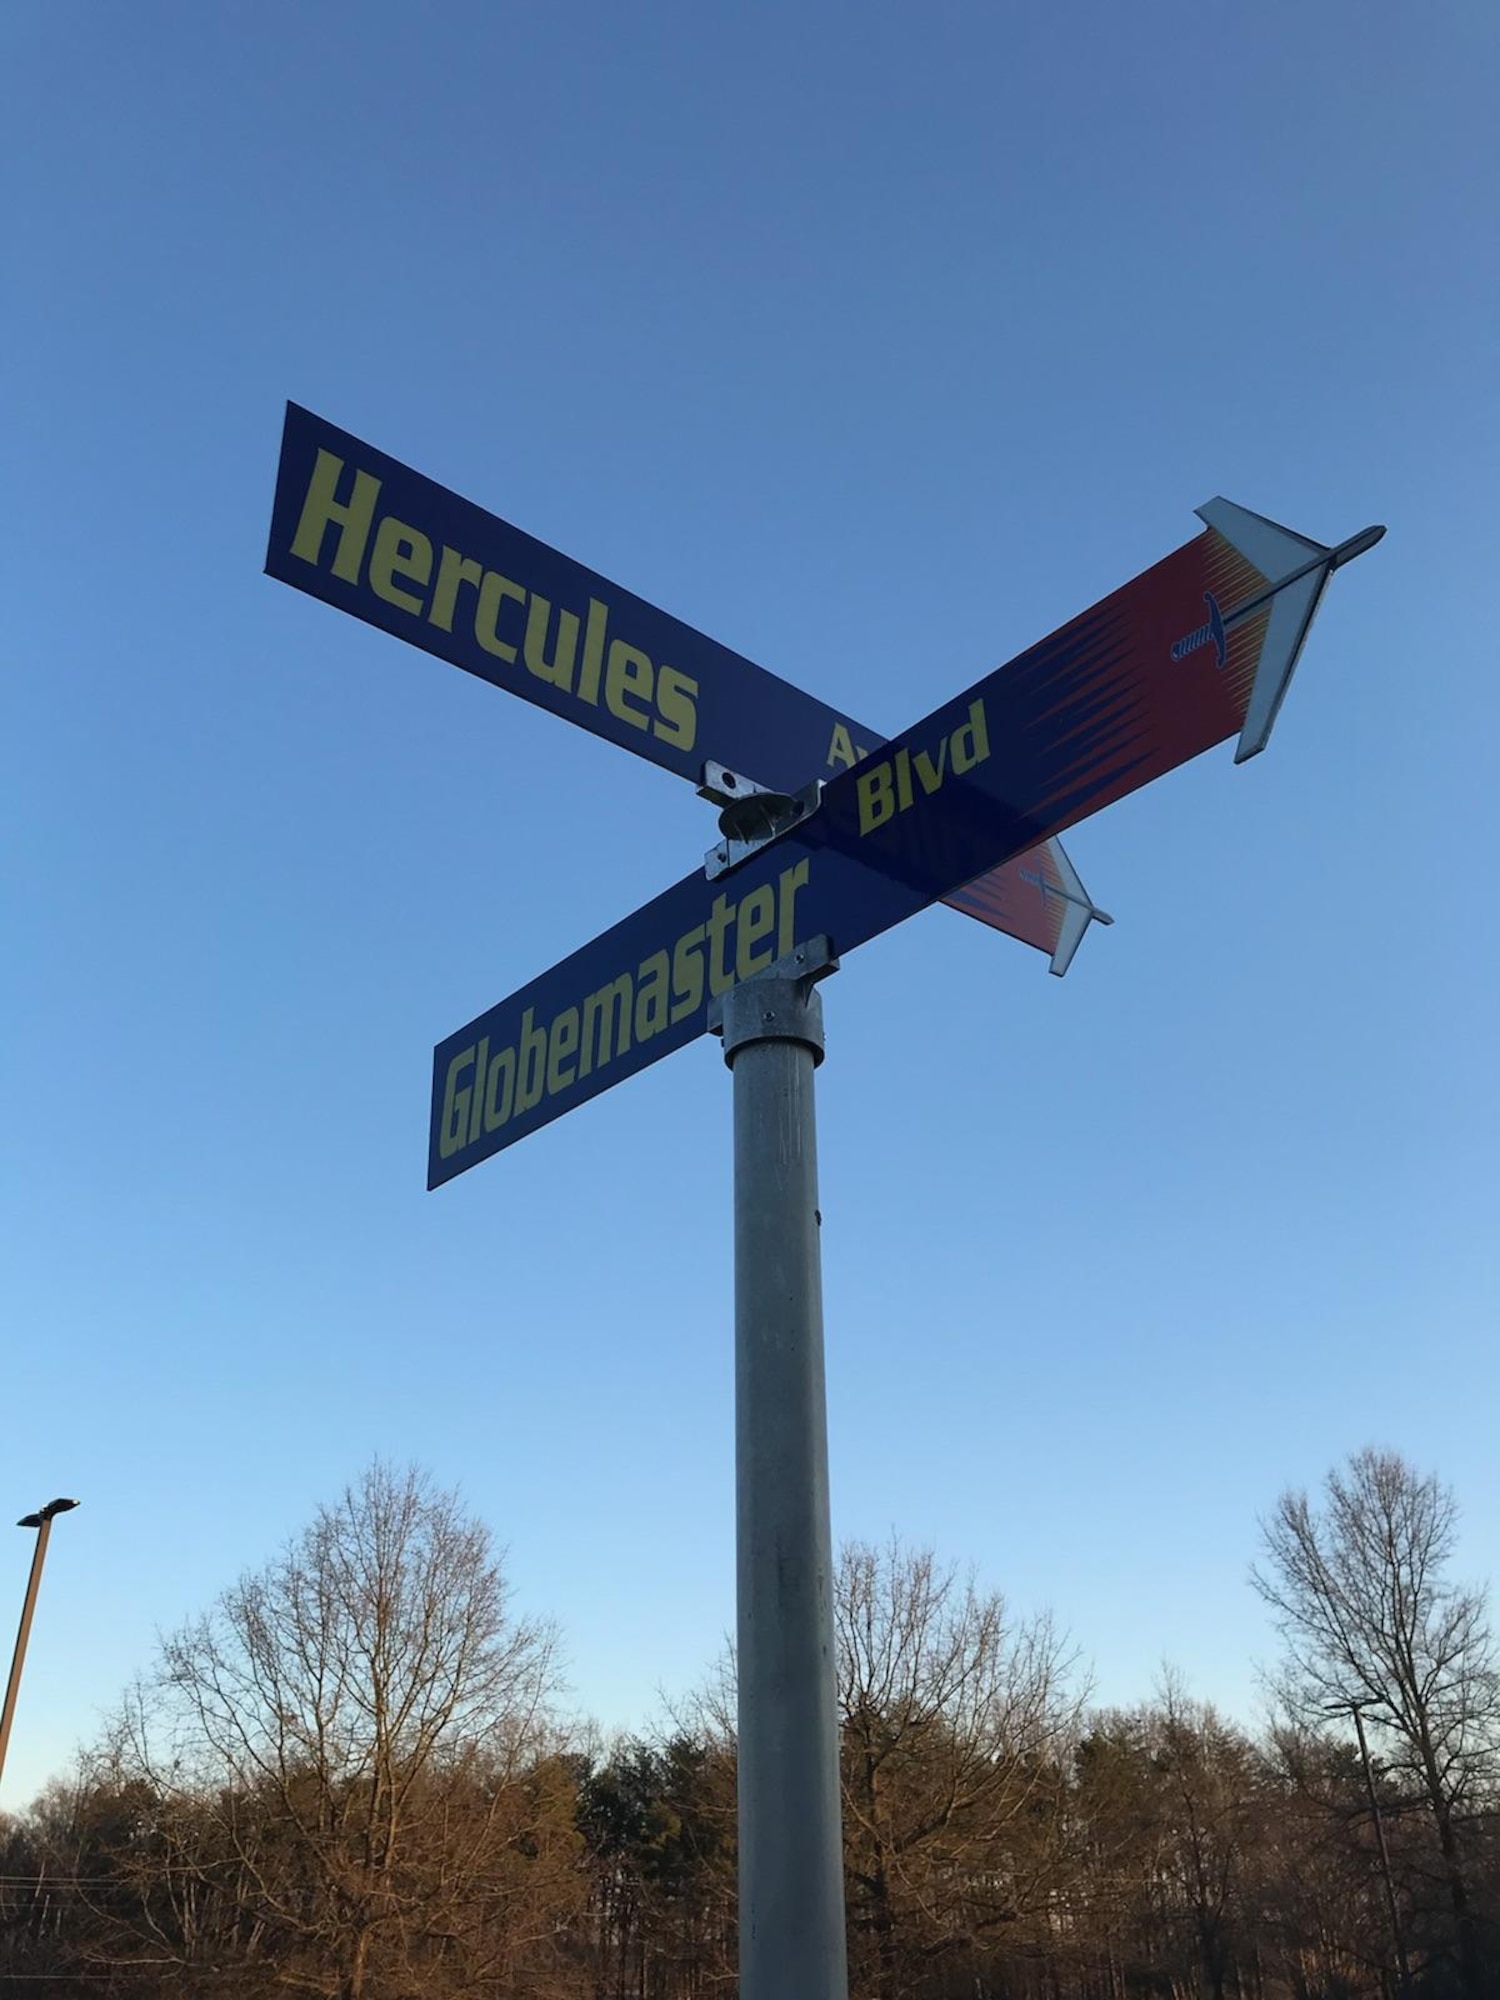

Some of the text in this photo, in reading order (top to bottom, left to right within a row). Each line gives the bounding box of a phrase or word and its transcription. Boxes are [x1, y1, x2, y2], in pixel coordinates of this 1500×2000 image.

[290, 447, 699, 752] Hercules
[439, 698, 991, 1159] Globemaster Blvd
